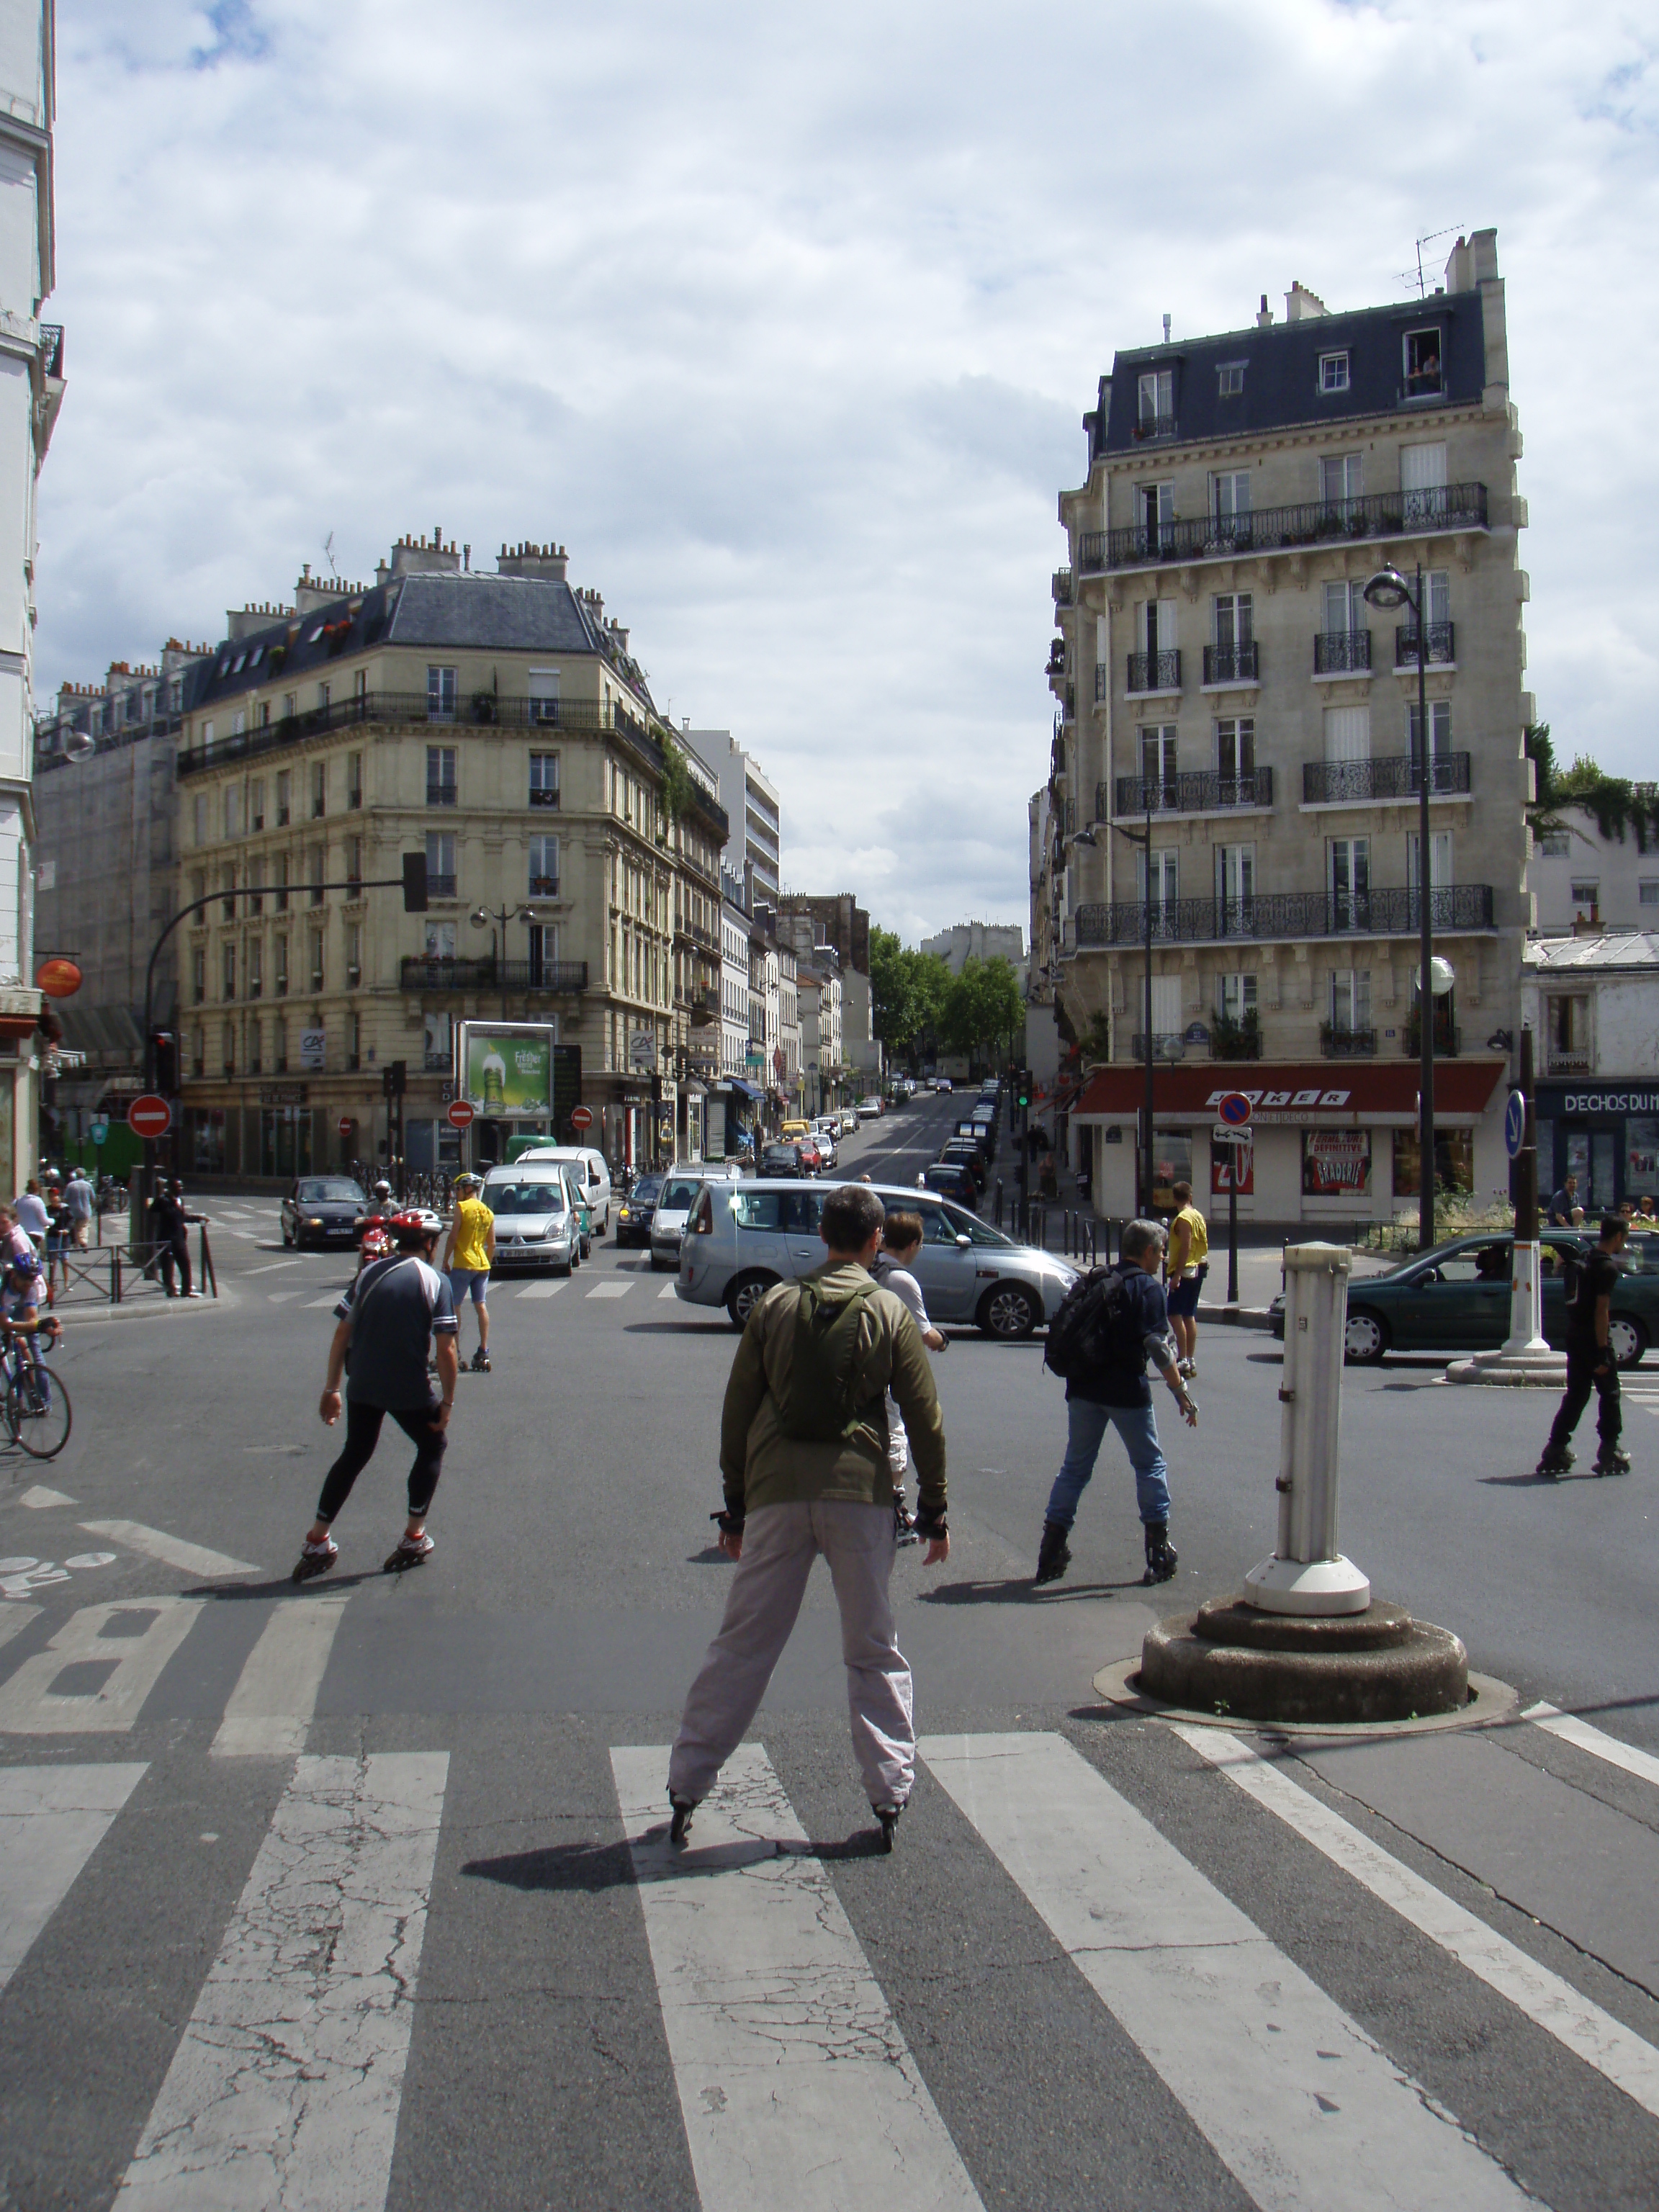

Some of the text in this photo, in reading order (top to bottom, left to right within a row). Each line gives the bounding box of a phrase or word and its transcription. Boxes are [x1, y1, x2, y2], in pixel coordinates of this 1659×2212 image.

[515, 1051, 541, 1064] Fresher
[1629, 1094, 1647, 1110] DU
[1314, 1143, 1362, 1152] DEFINITIVE
[1317, 1161, 1362, 1185] BRADERIE
